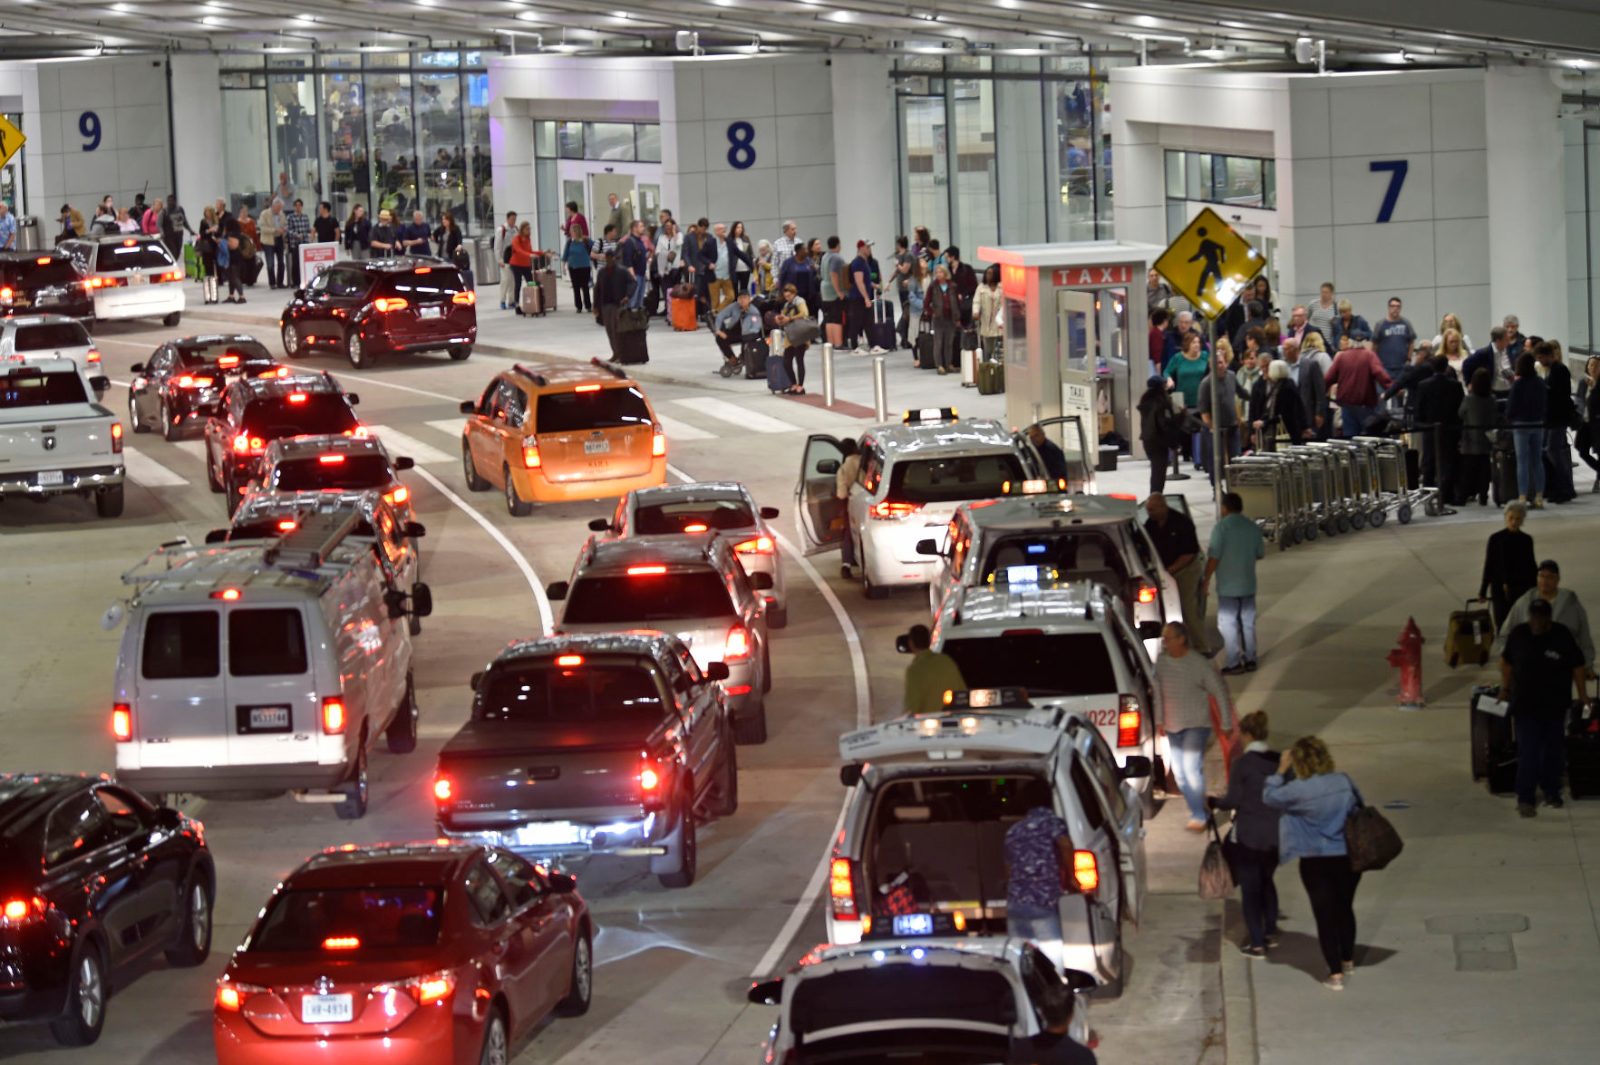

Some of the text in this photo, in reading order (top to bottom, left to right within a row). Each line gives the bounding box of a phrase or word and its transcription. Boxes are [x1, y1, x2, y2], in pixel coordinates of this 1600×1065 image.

[79, 111, 101, 151] 9
[727, 121, 756, 170] 8
[1370, 160, 1408, 223] 7
[1059, 267, 1127, 285] TAXI
